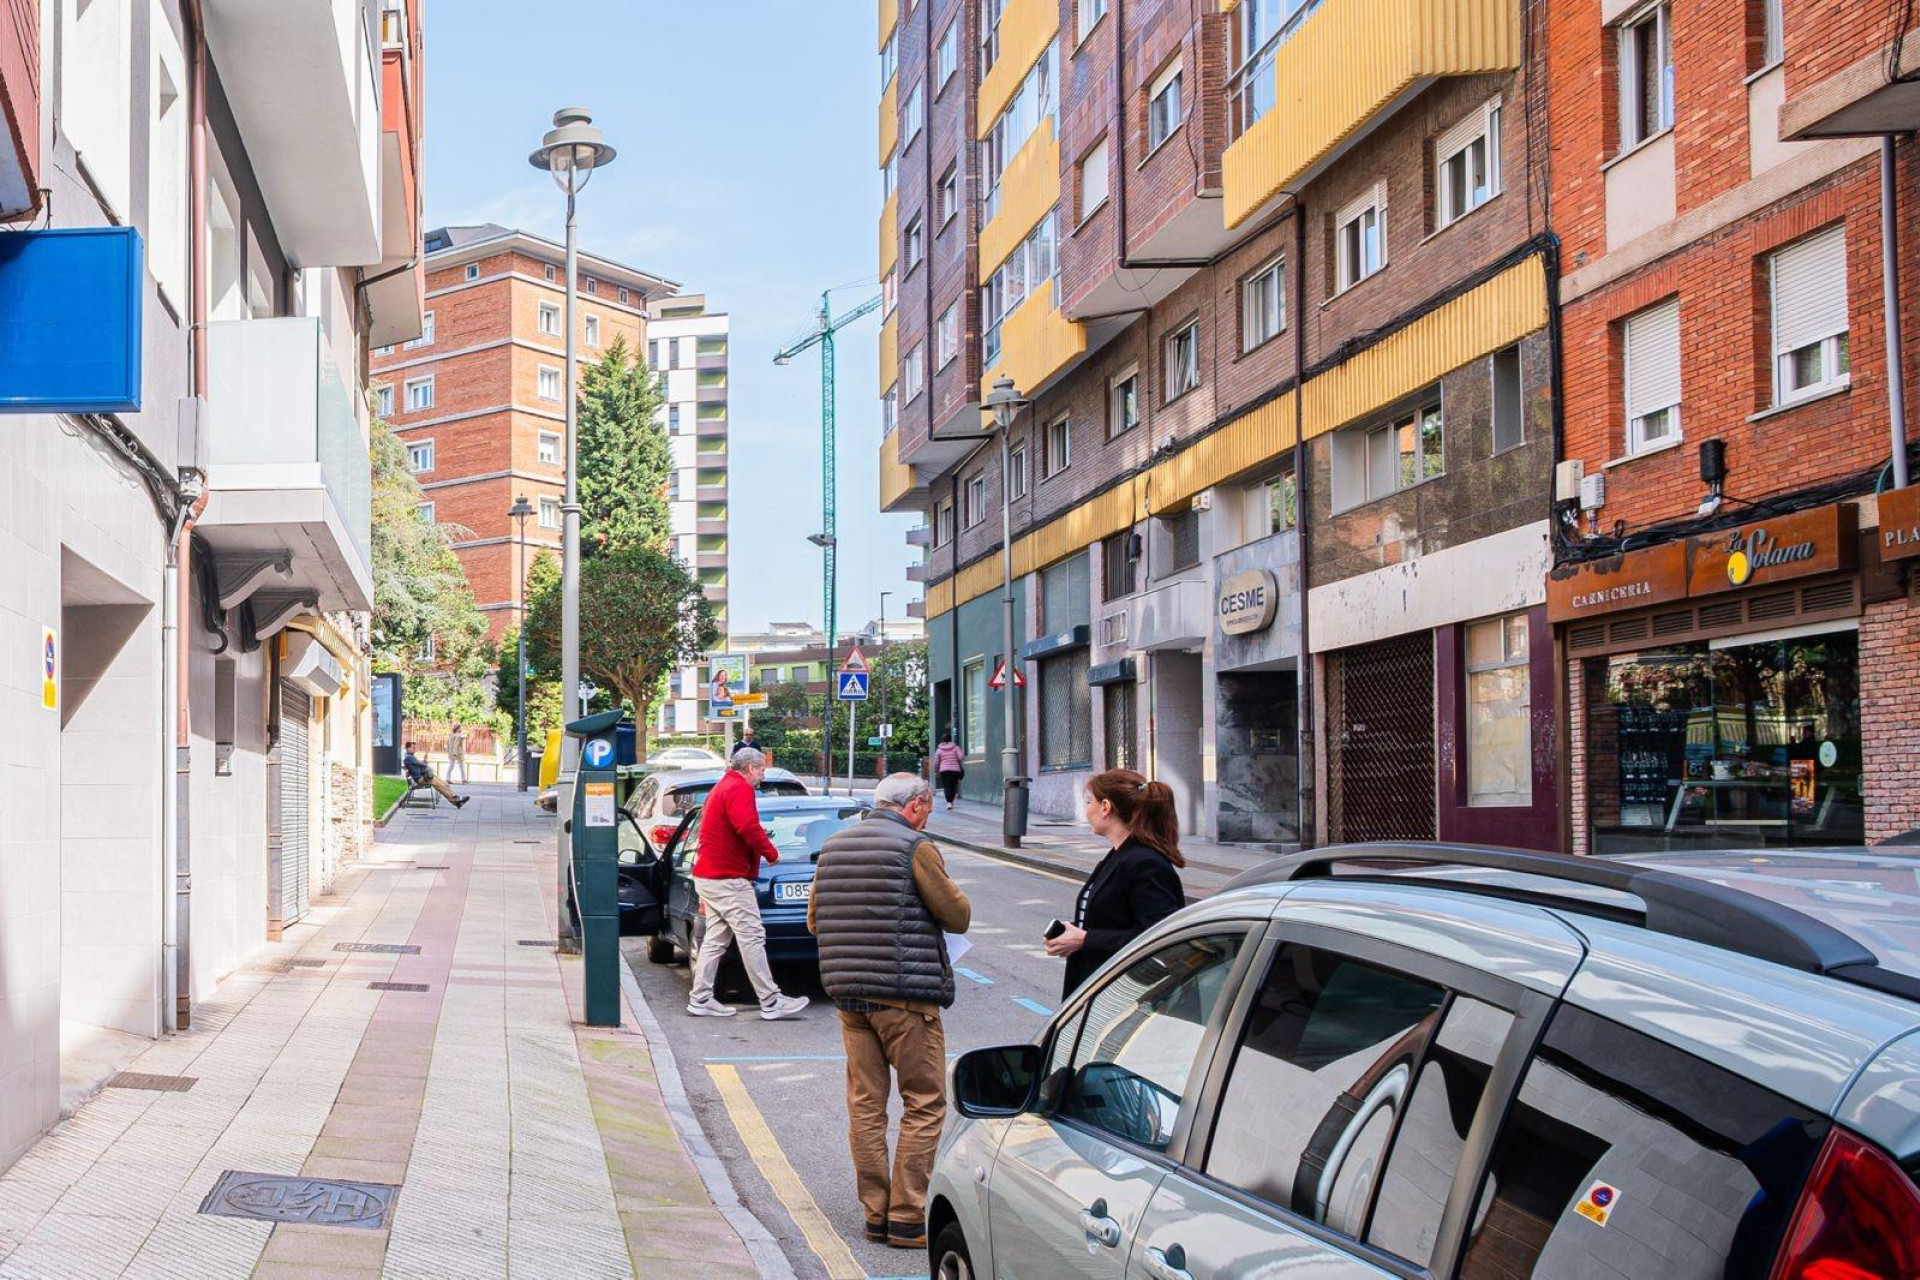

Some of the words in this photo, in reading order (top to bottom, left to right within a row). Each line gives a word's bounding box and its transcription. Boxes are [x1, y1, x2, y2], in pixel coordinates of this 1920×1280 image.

[1743, 529, 1814, 580] Solana
[1221, 586, 1264, 615] CESME
[593, 741, 612, 766] P
